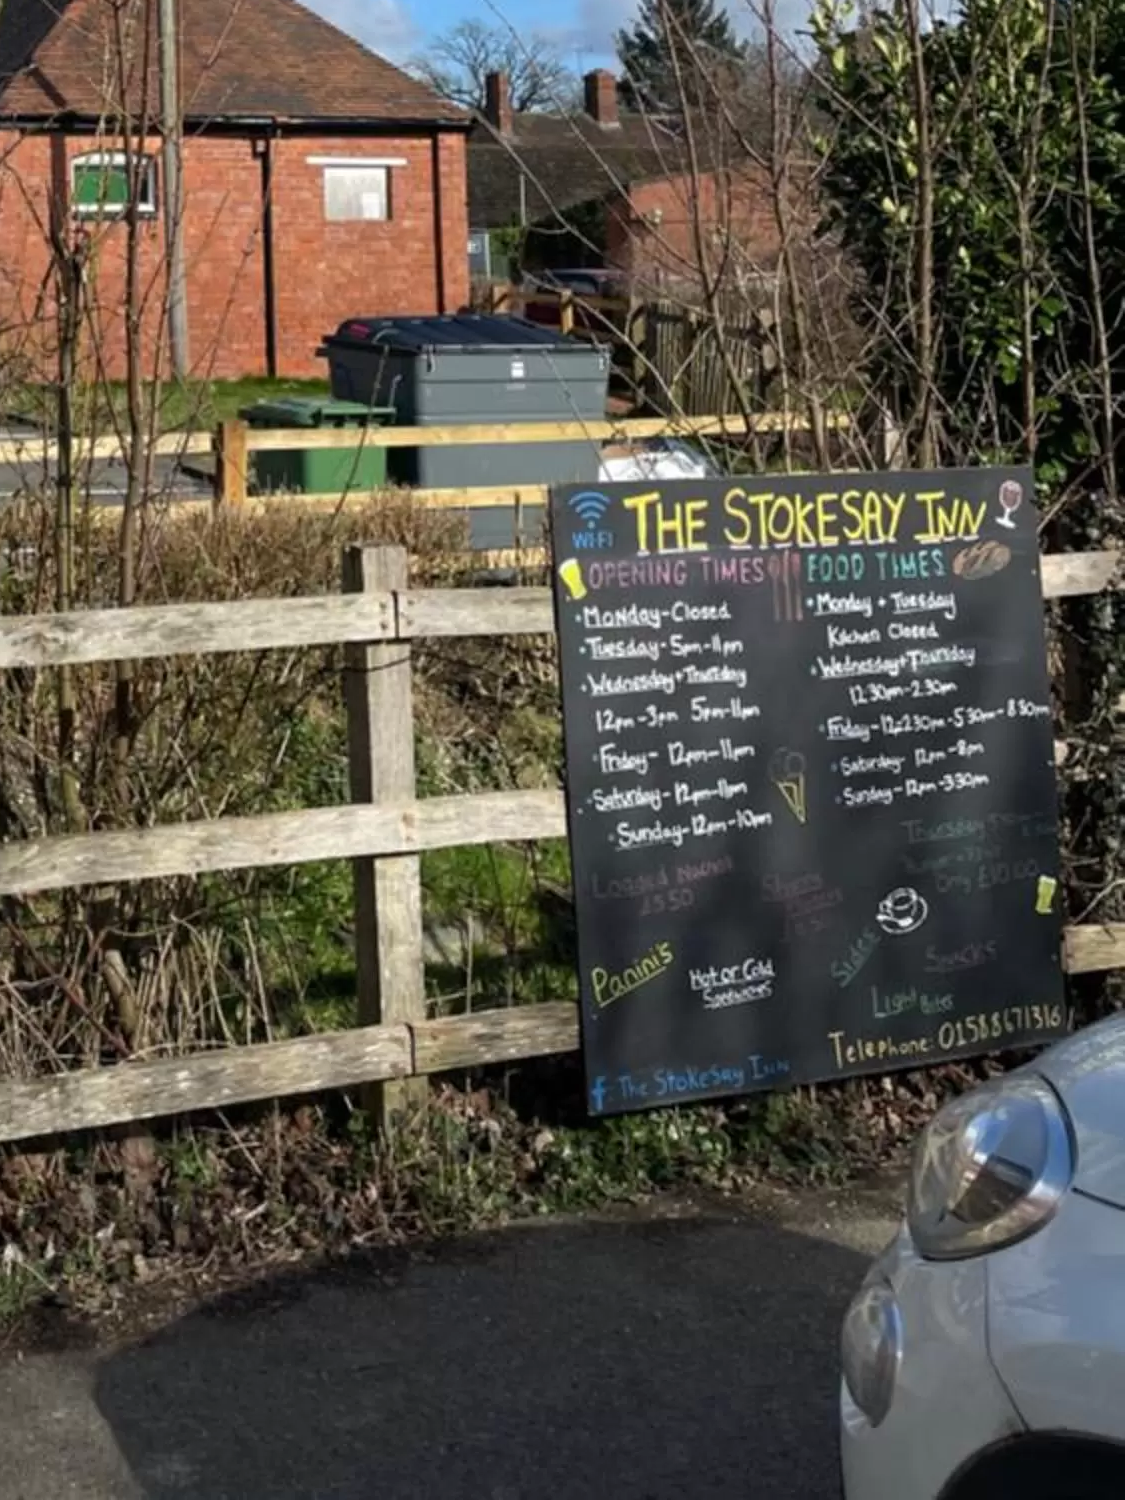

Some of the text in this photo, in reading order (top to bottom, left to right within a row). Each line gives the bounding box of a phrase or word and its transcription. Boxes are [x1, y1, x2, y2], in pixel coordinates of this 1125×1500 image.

[622, 486, 987, 557] THE STOKESAY INN
[588, 555, 765, 590] OPENING TIMES
[806, 549, 947, 582] FOOD TIMES
[815, 592, 873, 618] Monday
[890, 591, 957, 620] Tuesday
